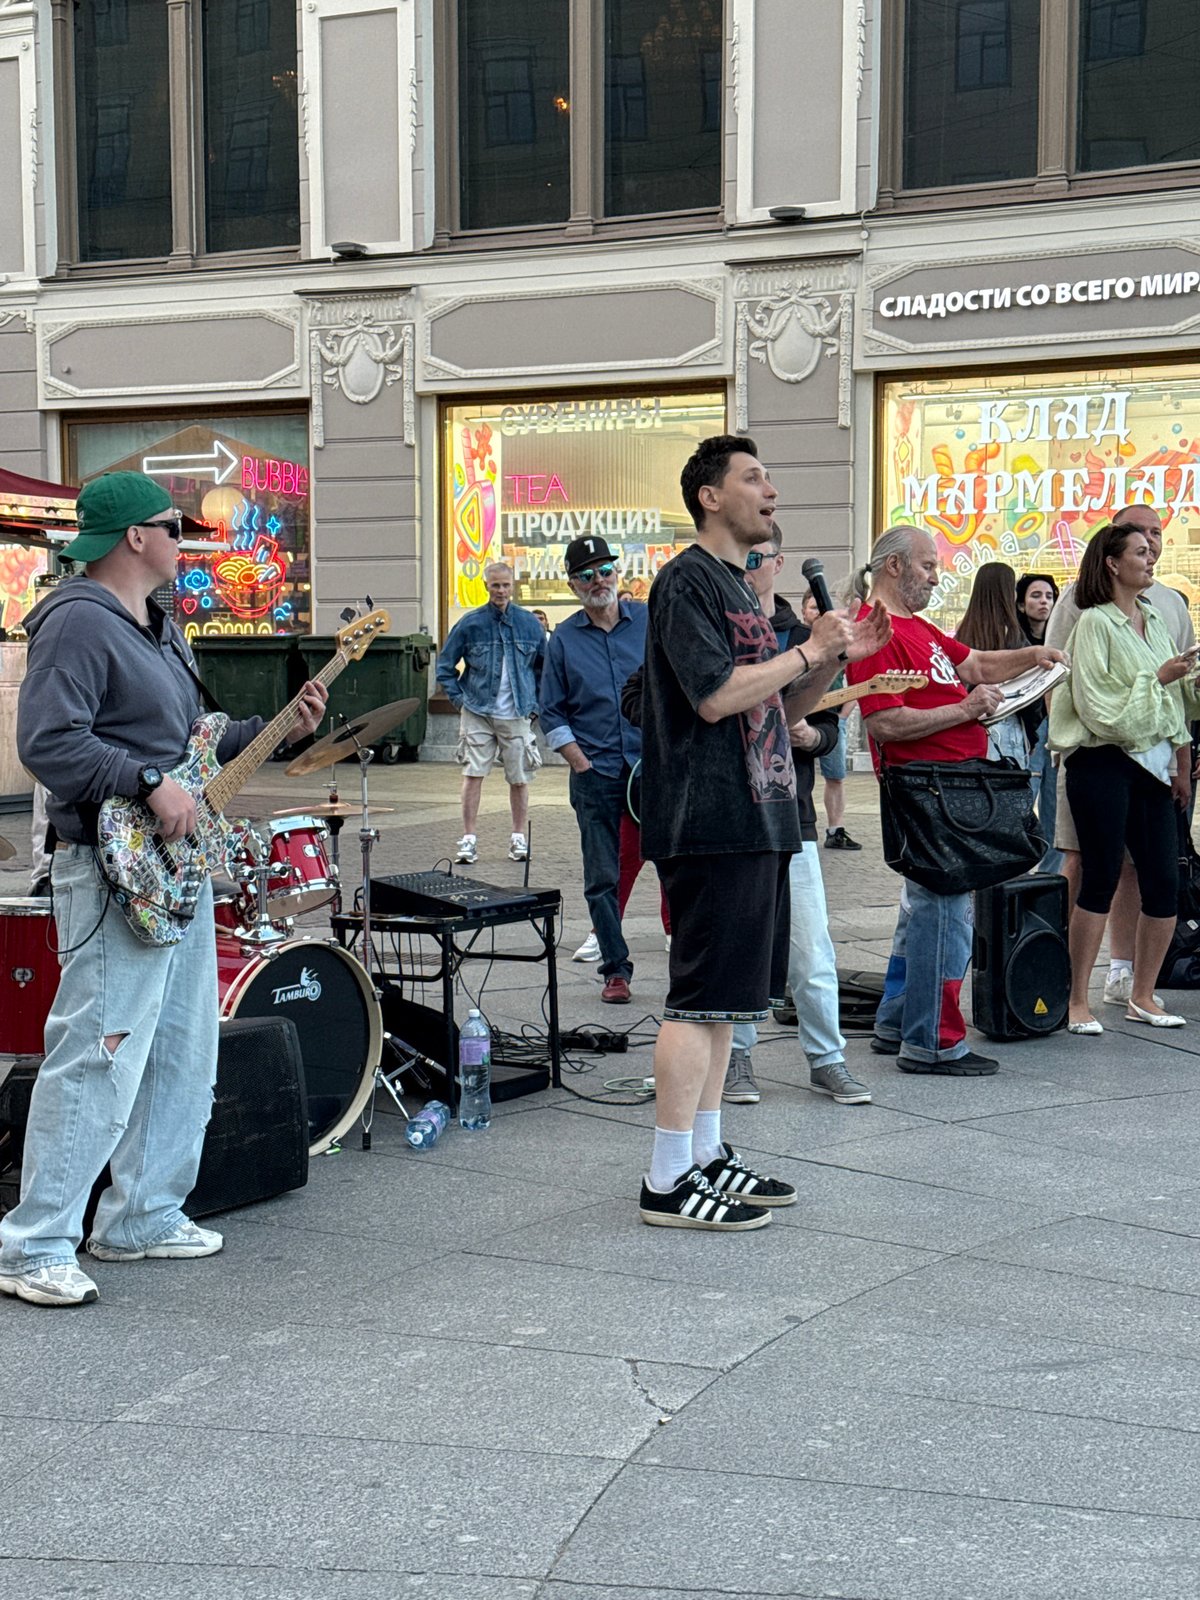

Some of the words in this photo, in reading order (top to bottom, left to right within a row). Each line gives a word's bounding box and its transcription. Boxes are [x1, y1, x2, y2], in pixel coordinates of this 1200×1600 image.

[879, 287, 1012, 319] СЛАДОСТИ
[1016, 284, 1050, 307] СО
[1055, 277, 1136, 304] ВСЕГО
[1140, 271, 1200, 297] МИР
[500, 397, 663, 437] СУВЕНИРЫ
[977, 391, 1132, 446] КЛАД
[504, 473, 569, 504] TEA
[507, 508, 662, 540] ПРОДУКЦИЯ
[462, 555, 567, 581] ФРИК
[271, 980, 322, 1005] TAMBURO
